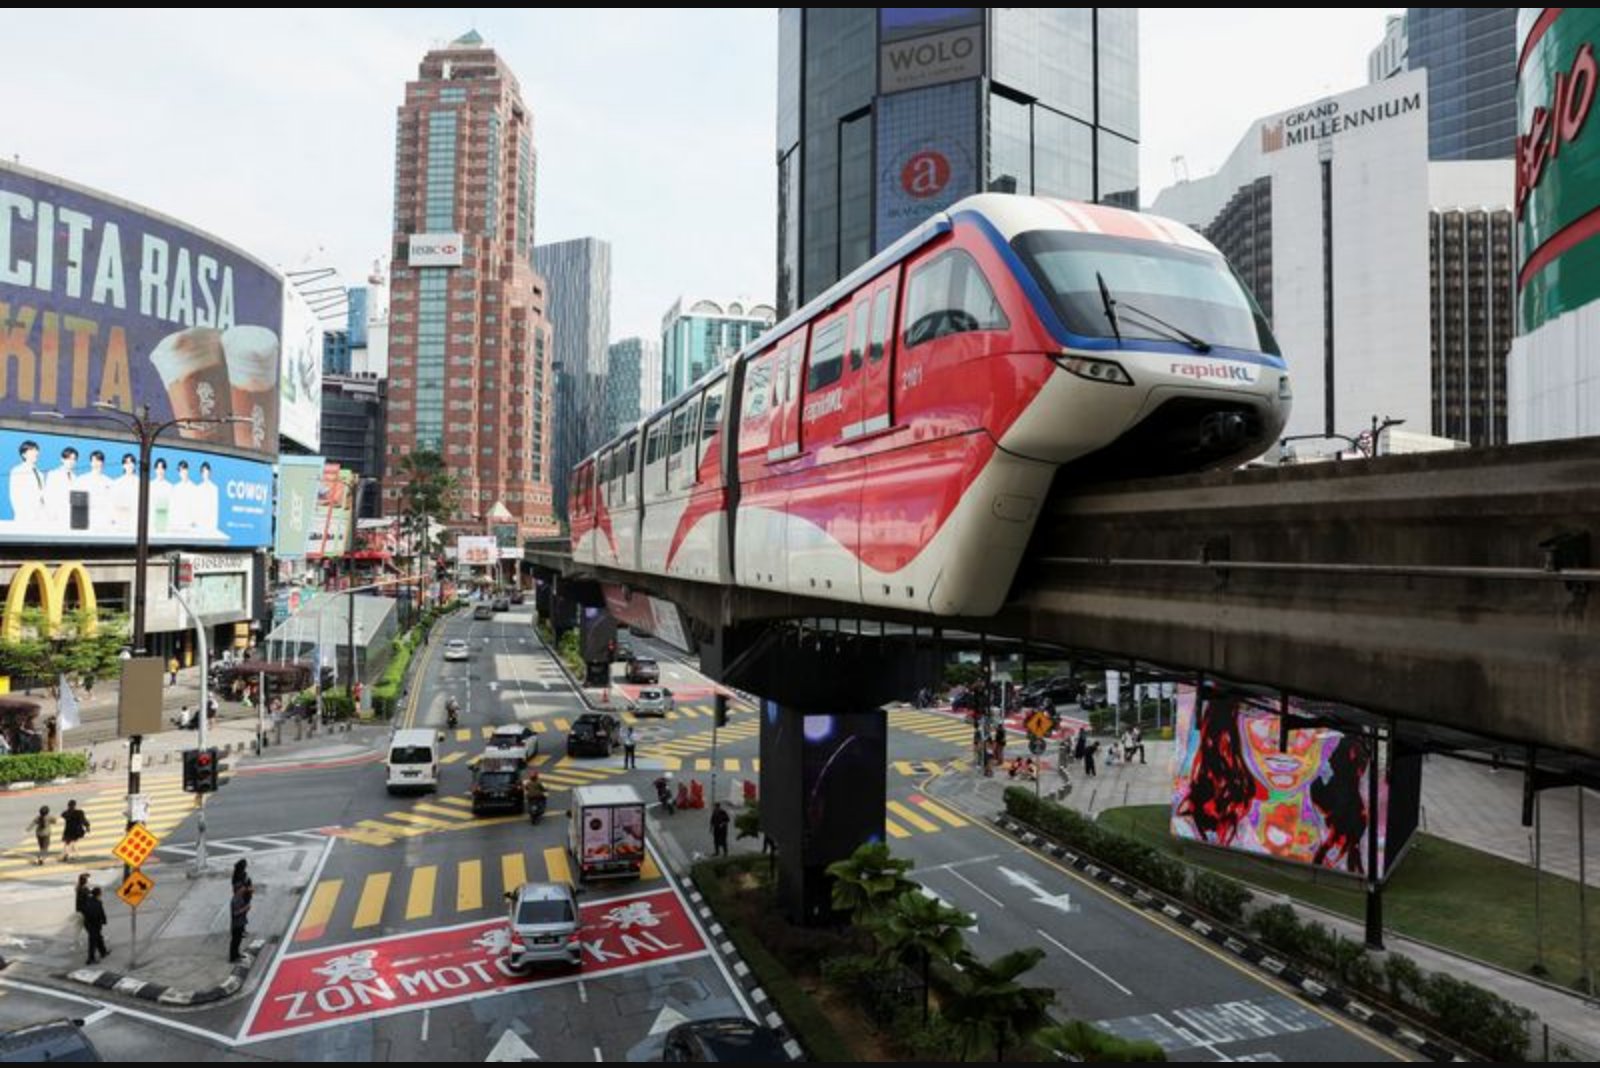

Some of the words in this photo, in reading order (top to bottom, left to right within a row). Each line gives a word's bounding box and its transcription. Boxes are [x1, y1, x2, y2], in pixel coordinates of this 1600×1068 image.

[889, 36, 973, 71] WOLO
[1286, 102, 1339, 127] GRAND
[1286, 92, 1421, 147] MILLENNIUM
[0, 190, 126, 309] CITA
[140, 233, 236, 331] RASA
[0, 302, 133, 413] KITA
[1171, 363, 1255, 382] rapidKL
[274, 977, 397, 1021] ZON
